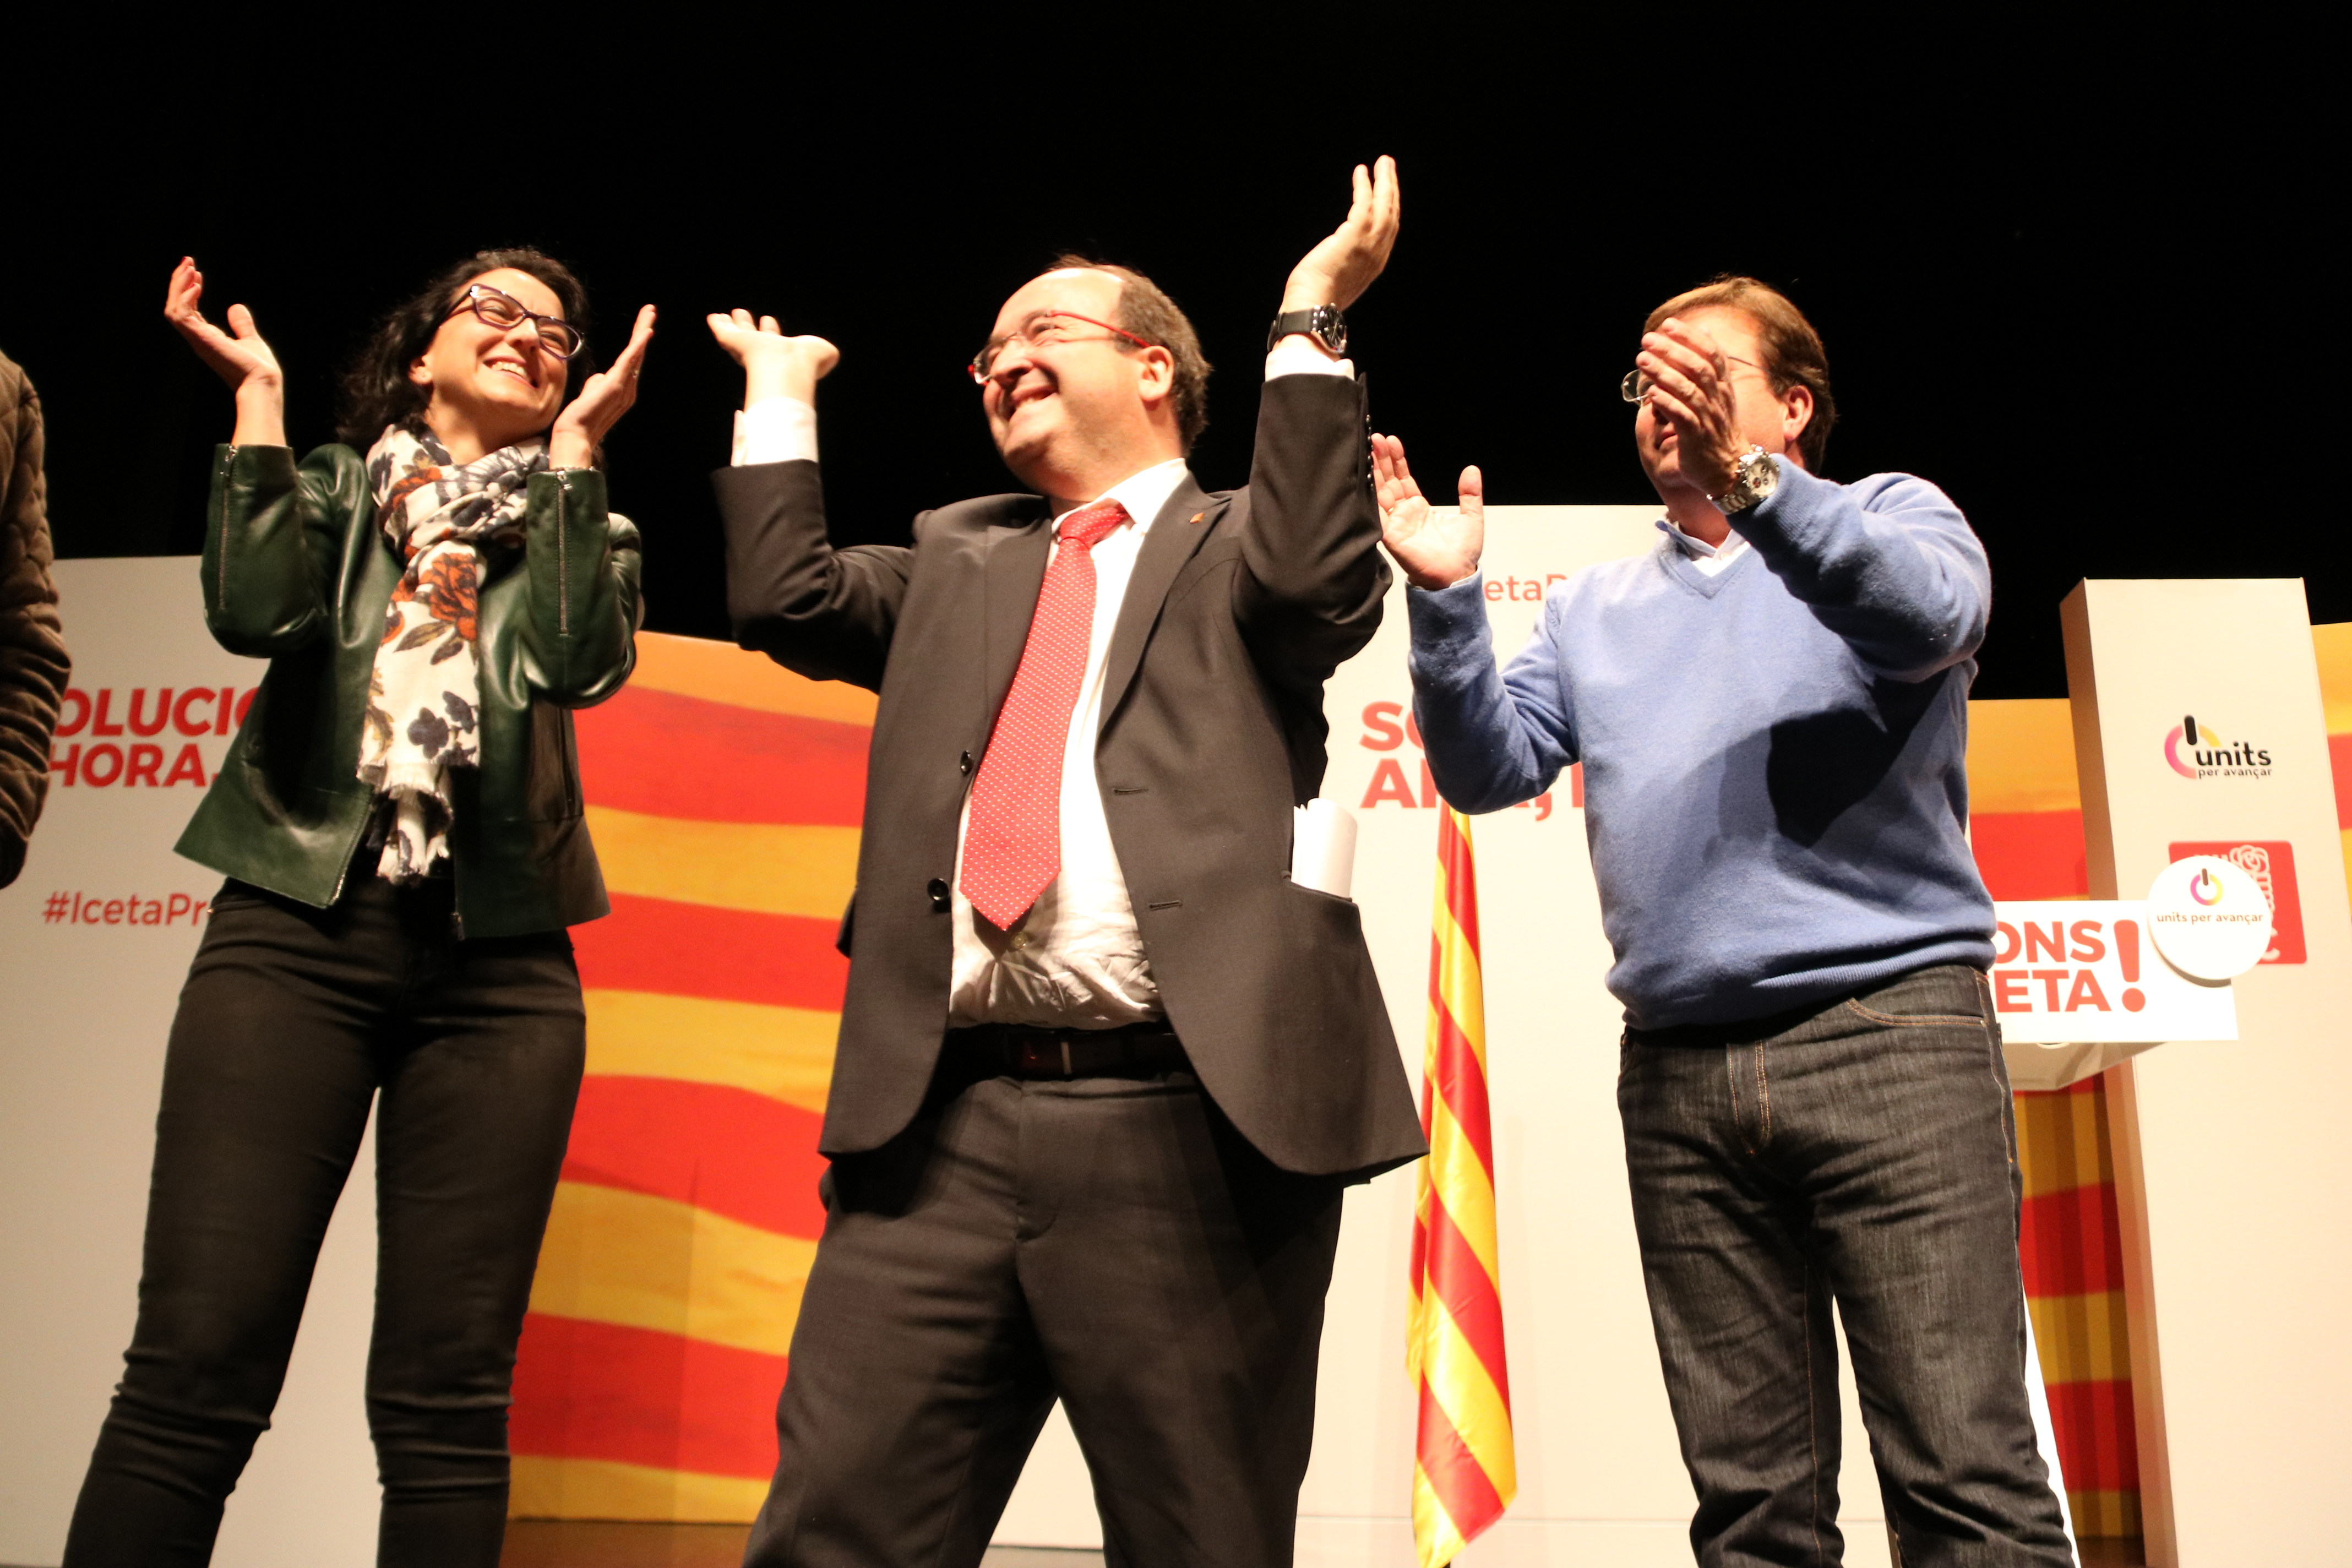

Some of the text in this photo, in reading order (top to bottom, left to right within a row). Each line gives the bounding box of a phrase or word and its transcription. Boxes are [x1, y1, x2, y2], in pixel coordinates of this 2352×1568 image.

[2195, 741, 2272, 766] units
[2198, 768, 2273, 779] per avançar
[42, 891, 209, 927] #IcetaPr
[2157, 912, 2263, 925] units per avançar
